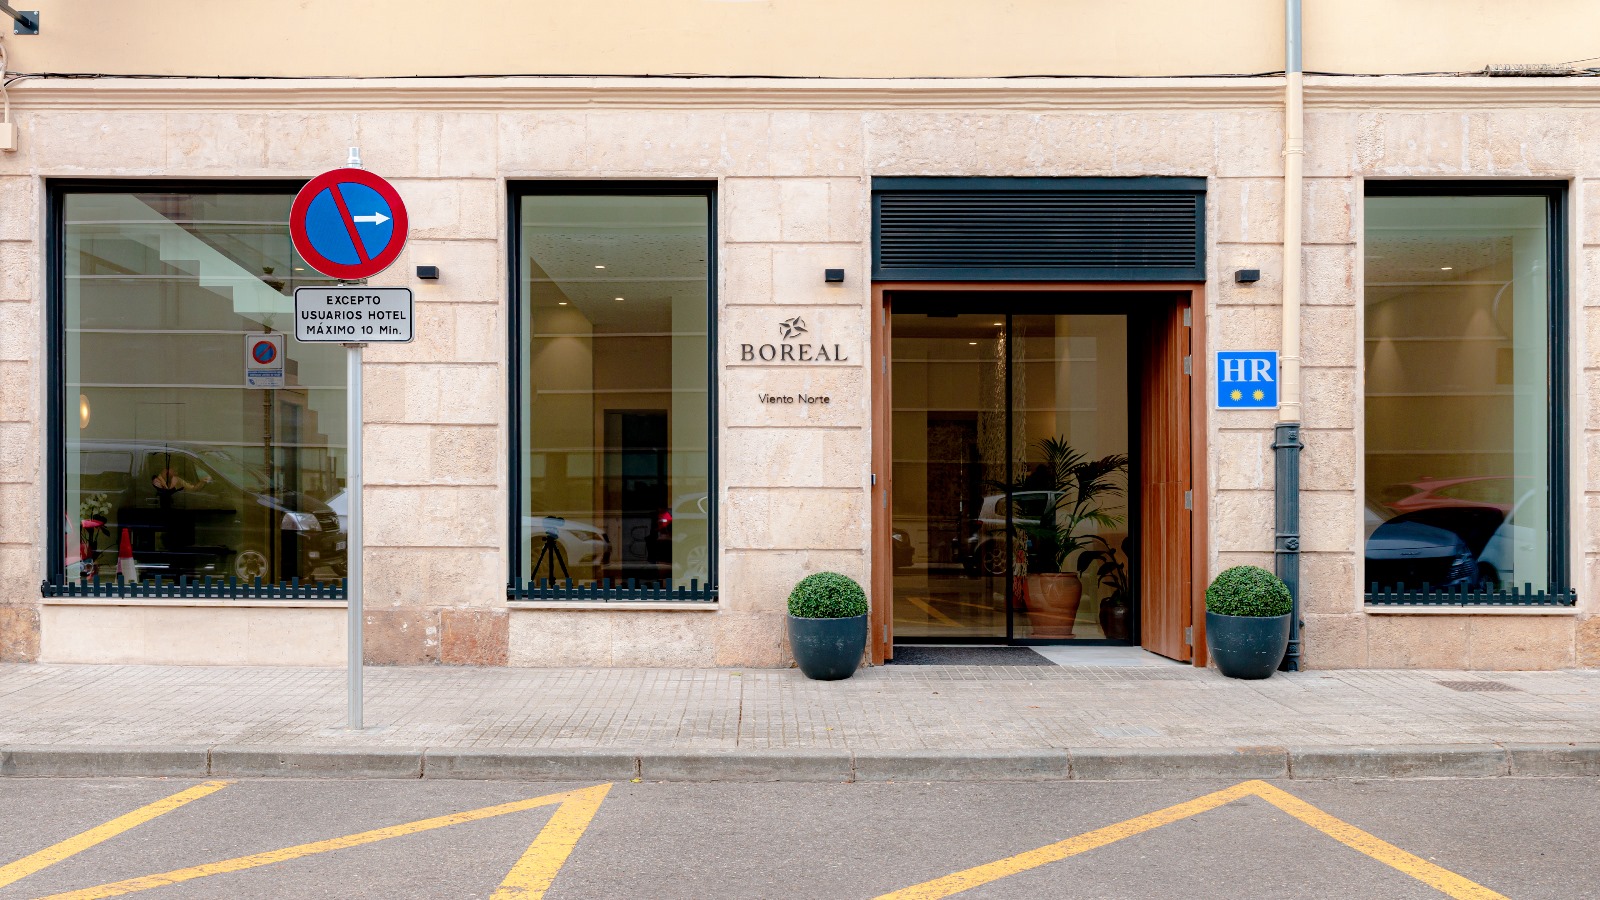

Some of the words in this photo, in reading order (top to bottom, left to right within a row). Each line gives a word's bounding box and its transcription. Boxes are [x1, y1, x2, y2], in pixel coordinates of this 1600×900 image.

[326, 295, 381, 305] EXCEPTO
[301, 310, 362, 320] USUARIOS
[368, 310, 407, 320] HOTEL
[306, 322, 355, 335] MÁXIMO
[361, 325, 374, 335] 10
[379, 325, 402, 335] Min.
[740, 343, 848, 362] BOREAL
[1220, 358, 1275, 382] HR
[758, 393, 794, 404] Viento
[798, 393, 830, 404] Norte
